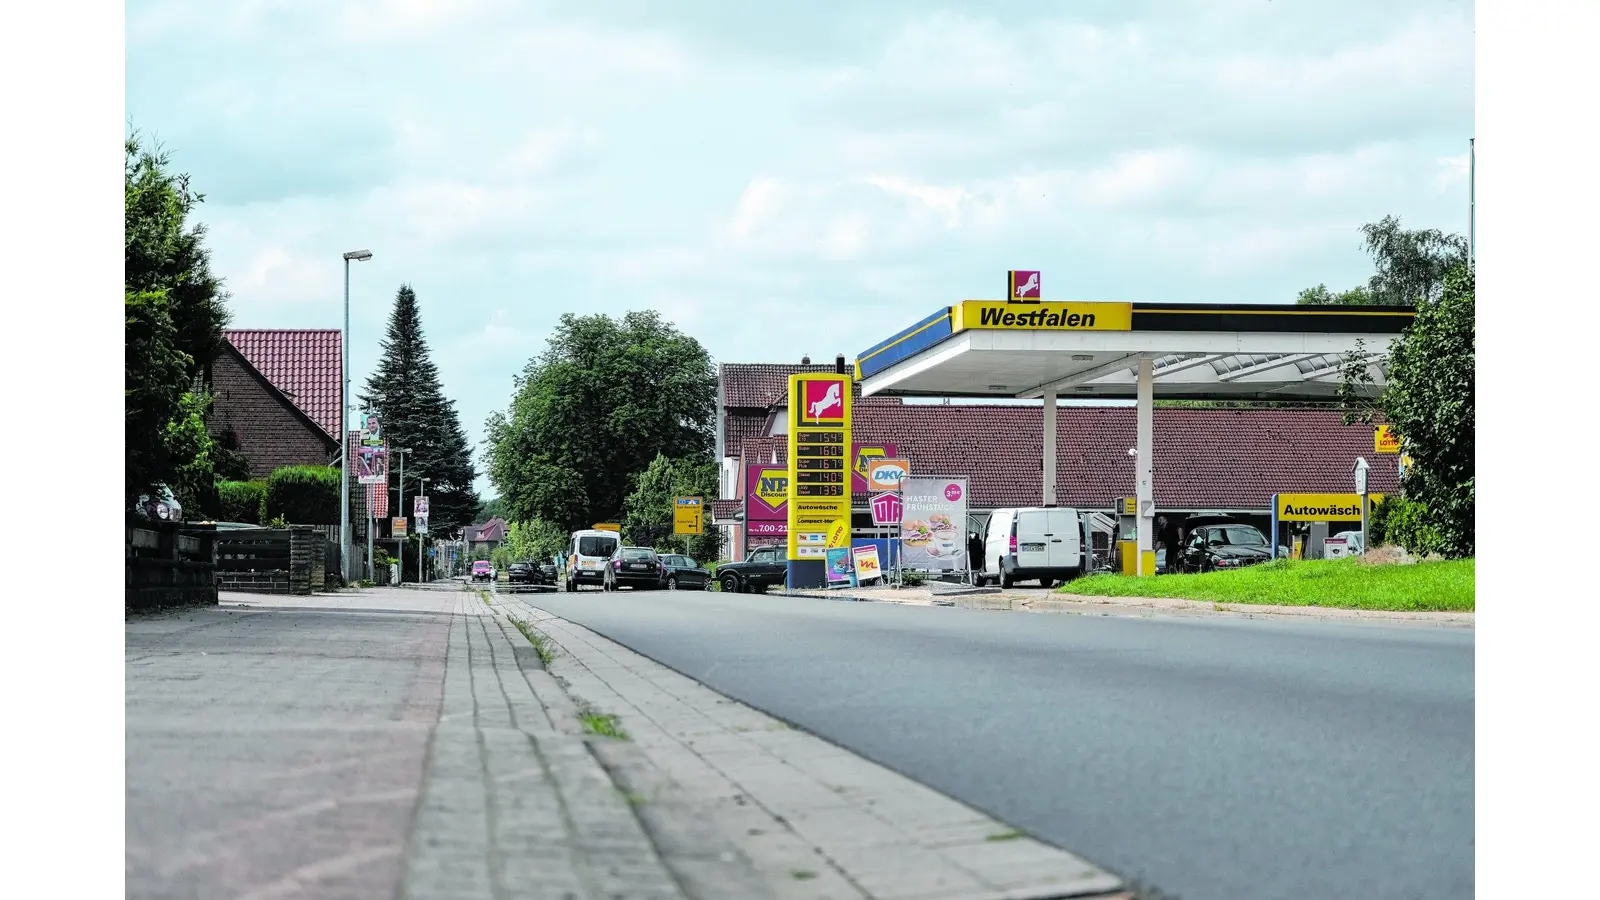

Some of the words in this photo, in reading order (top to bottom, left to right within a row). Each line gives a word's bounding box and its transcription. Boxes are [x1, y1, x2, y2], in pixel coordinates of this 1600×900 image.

[980, 307, 1096, 327] Westfalen
[875, 470, 904, 480] DKV
[906, 502, 955, 511] FRÜHSTÜCK
[1284, 504, 1362, 516] Autowäsch
[832, 526, 844, 544] LOTTO
